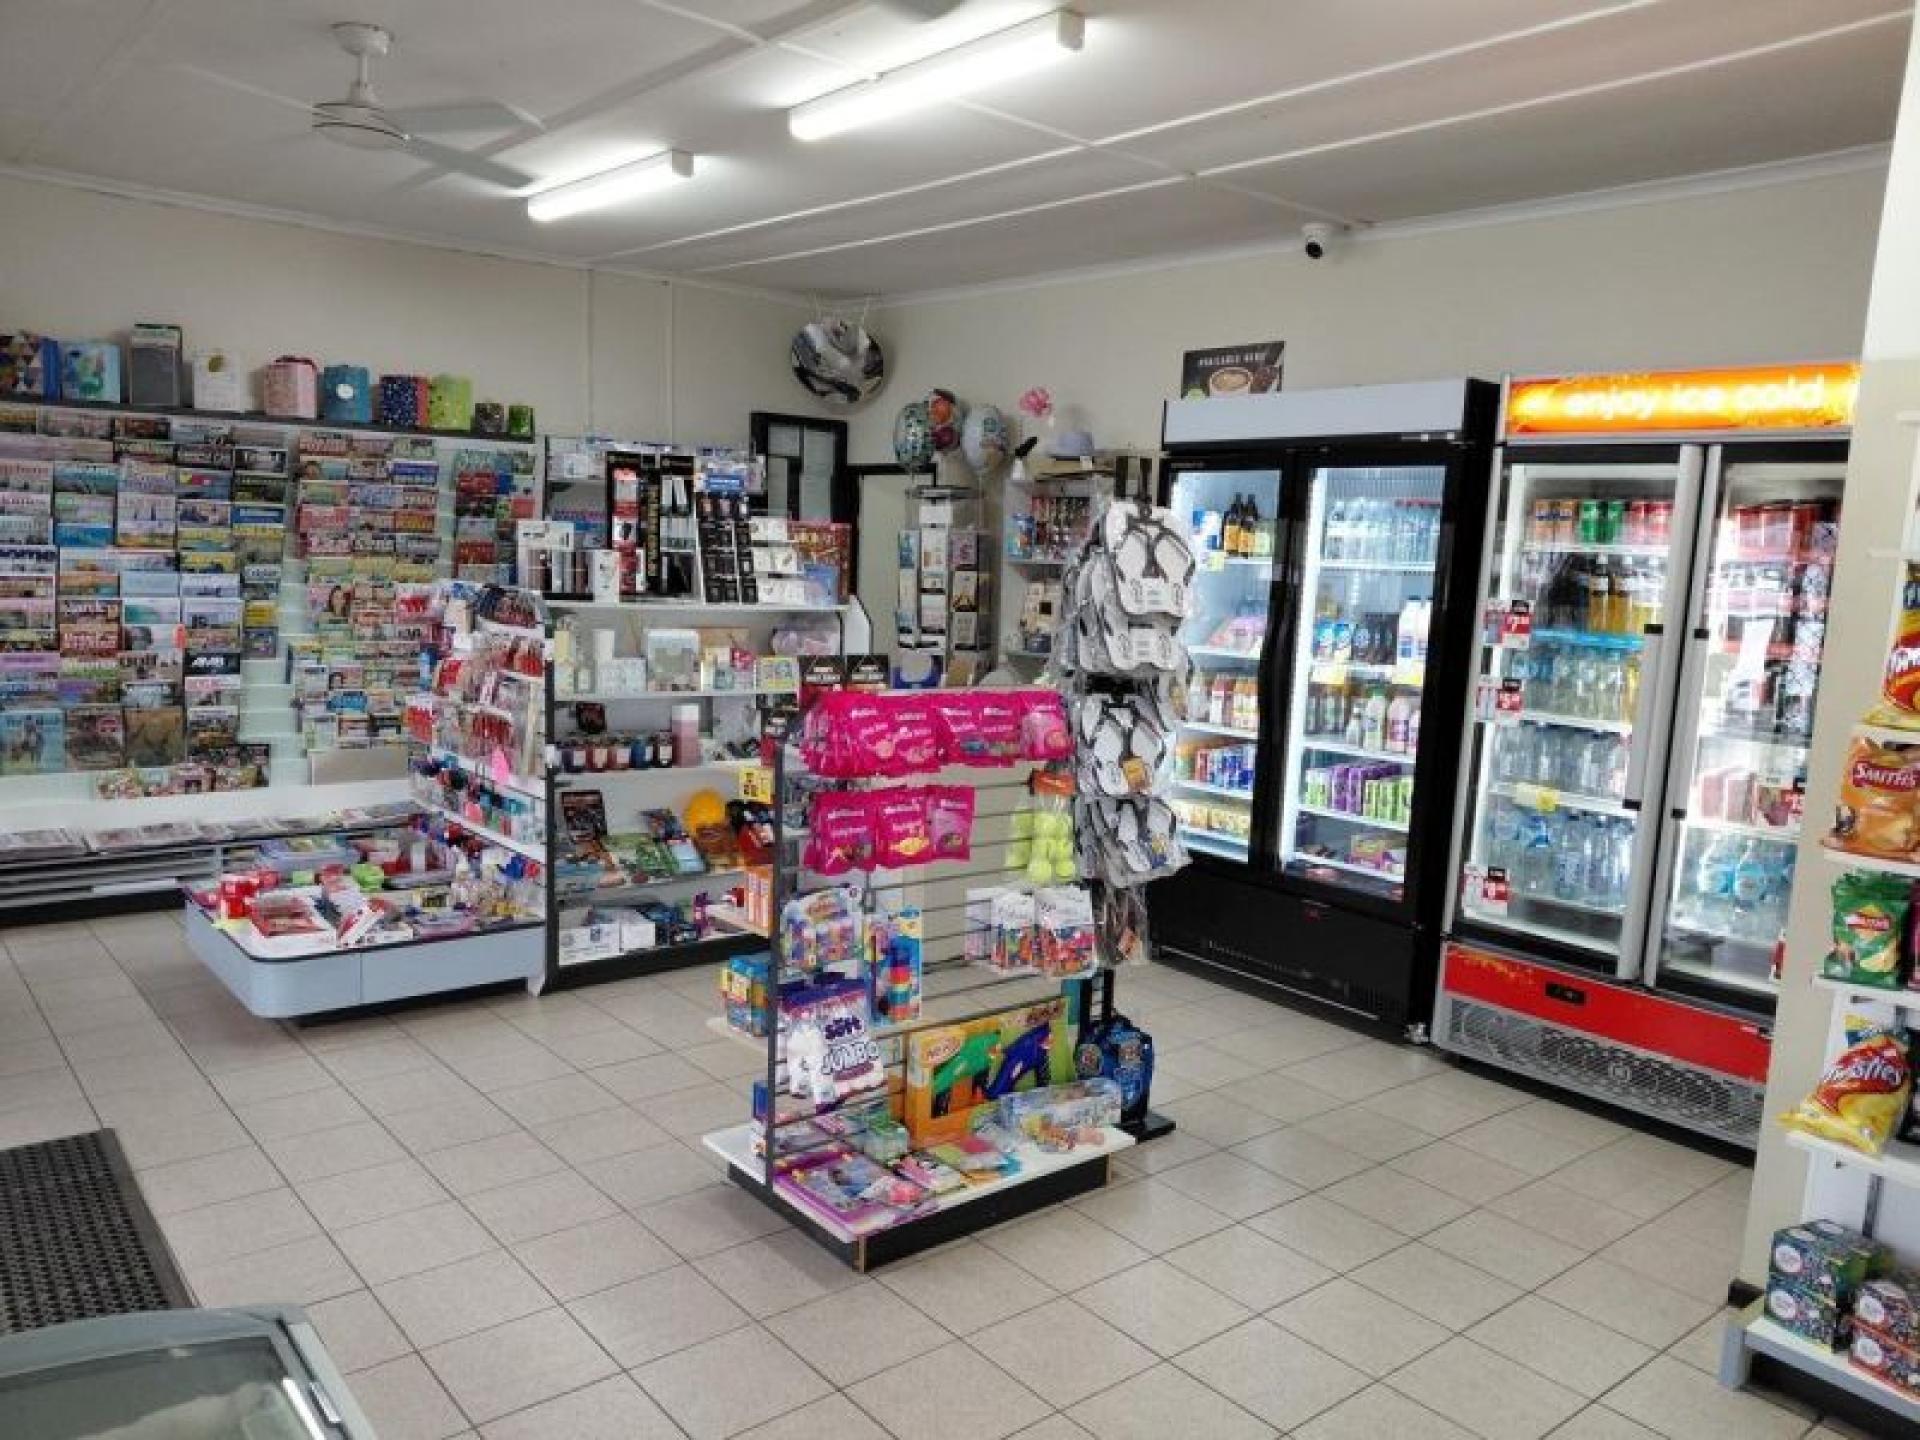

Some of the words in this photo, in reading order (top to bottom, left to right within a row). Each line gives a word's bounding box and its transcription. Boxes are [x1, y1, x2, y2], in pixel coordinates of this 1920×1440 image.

[1564, 386, 1657, 420] enjoy
[1673, 383, 1722, 412] ice
[1738, 374, 1825, 411] cold
[821, 1040, 880, 1076] JUMBO
